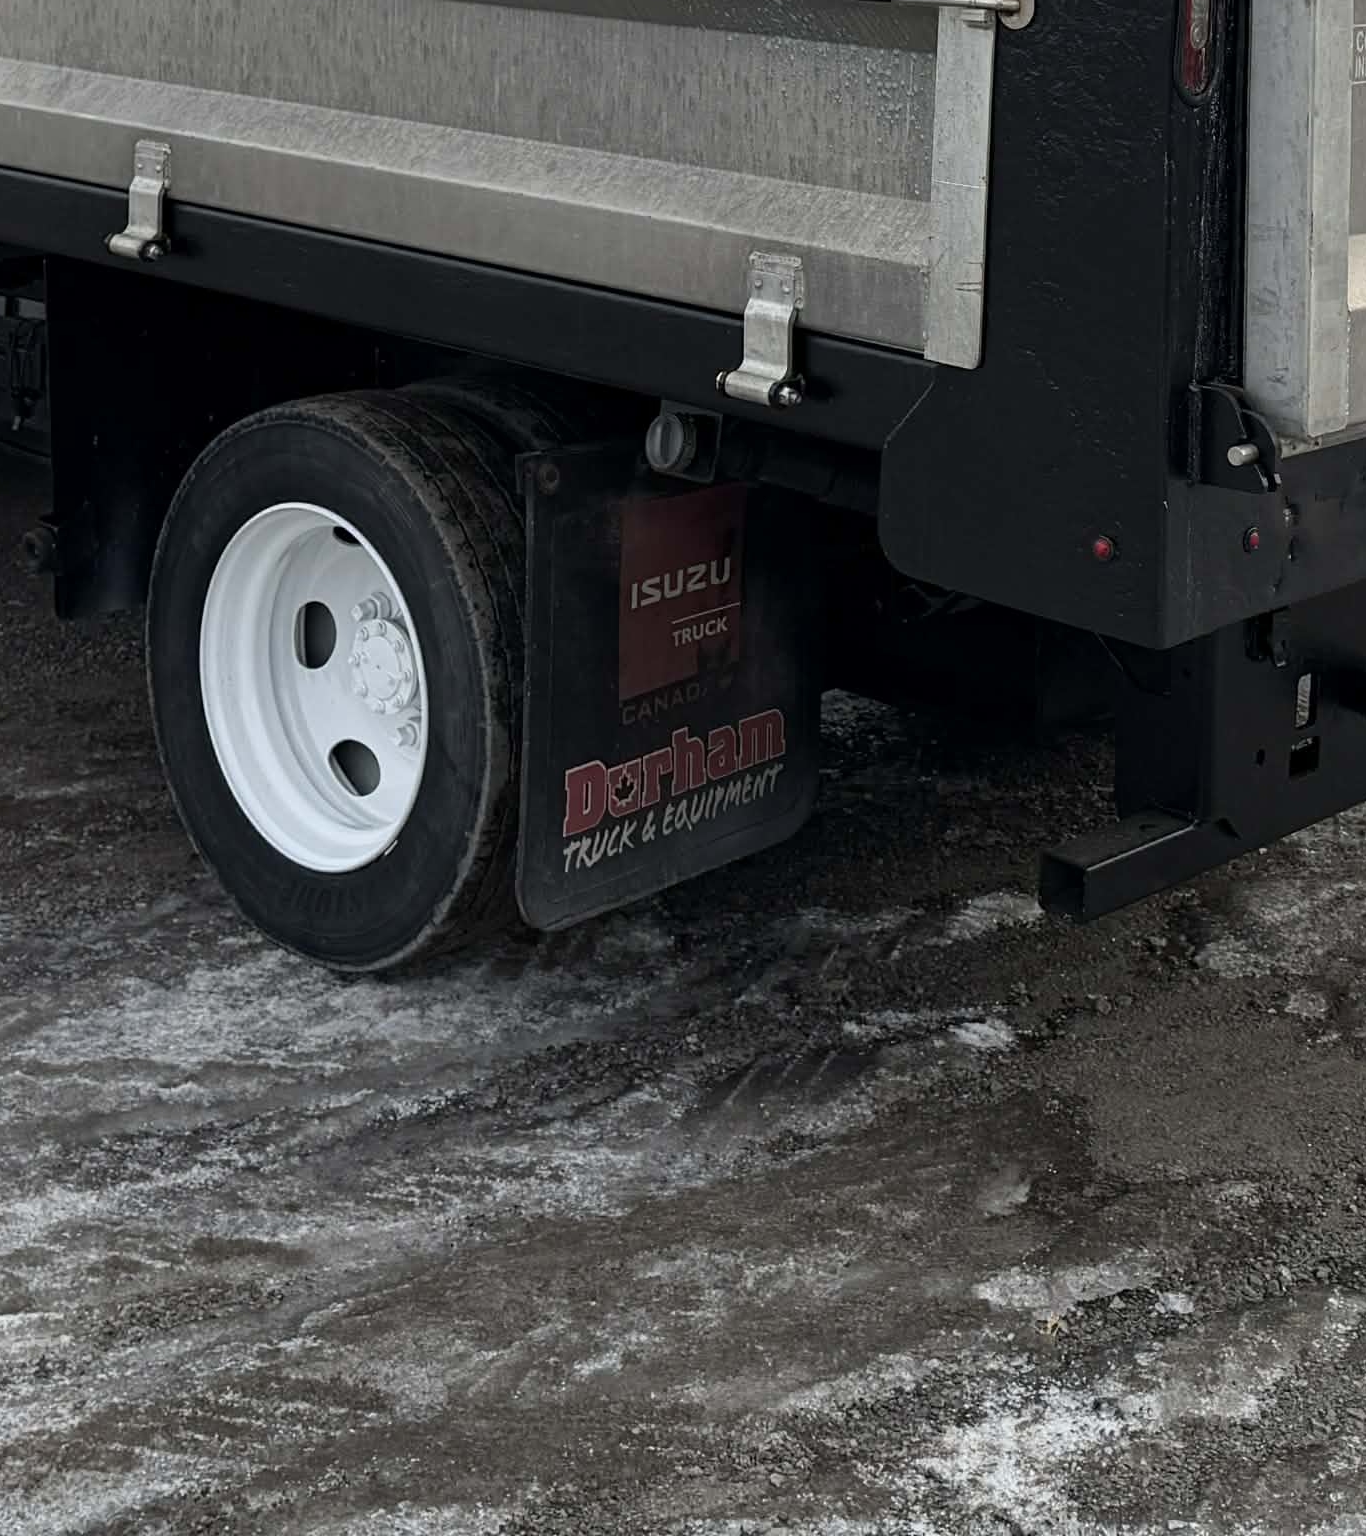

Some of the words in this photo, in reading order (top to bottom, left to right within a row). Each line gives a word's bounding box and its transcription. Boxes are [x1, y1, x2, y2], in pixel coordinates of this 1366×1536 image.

[630, 557, 731, 609] ISUZU
[672, 616, 729, 647] TRUCK
[563, 708, 786, 837] Durham
[563, 819, 638, 873] TRUCK
[641, 811, 657, 842] &
[662, 763, 784, 836] EQUIPMENT
